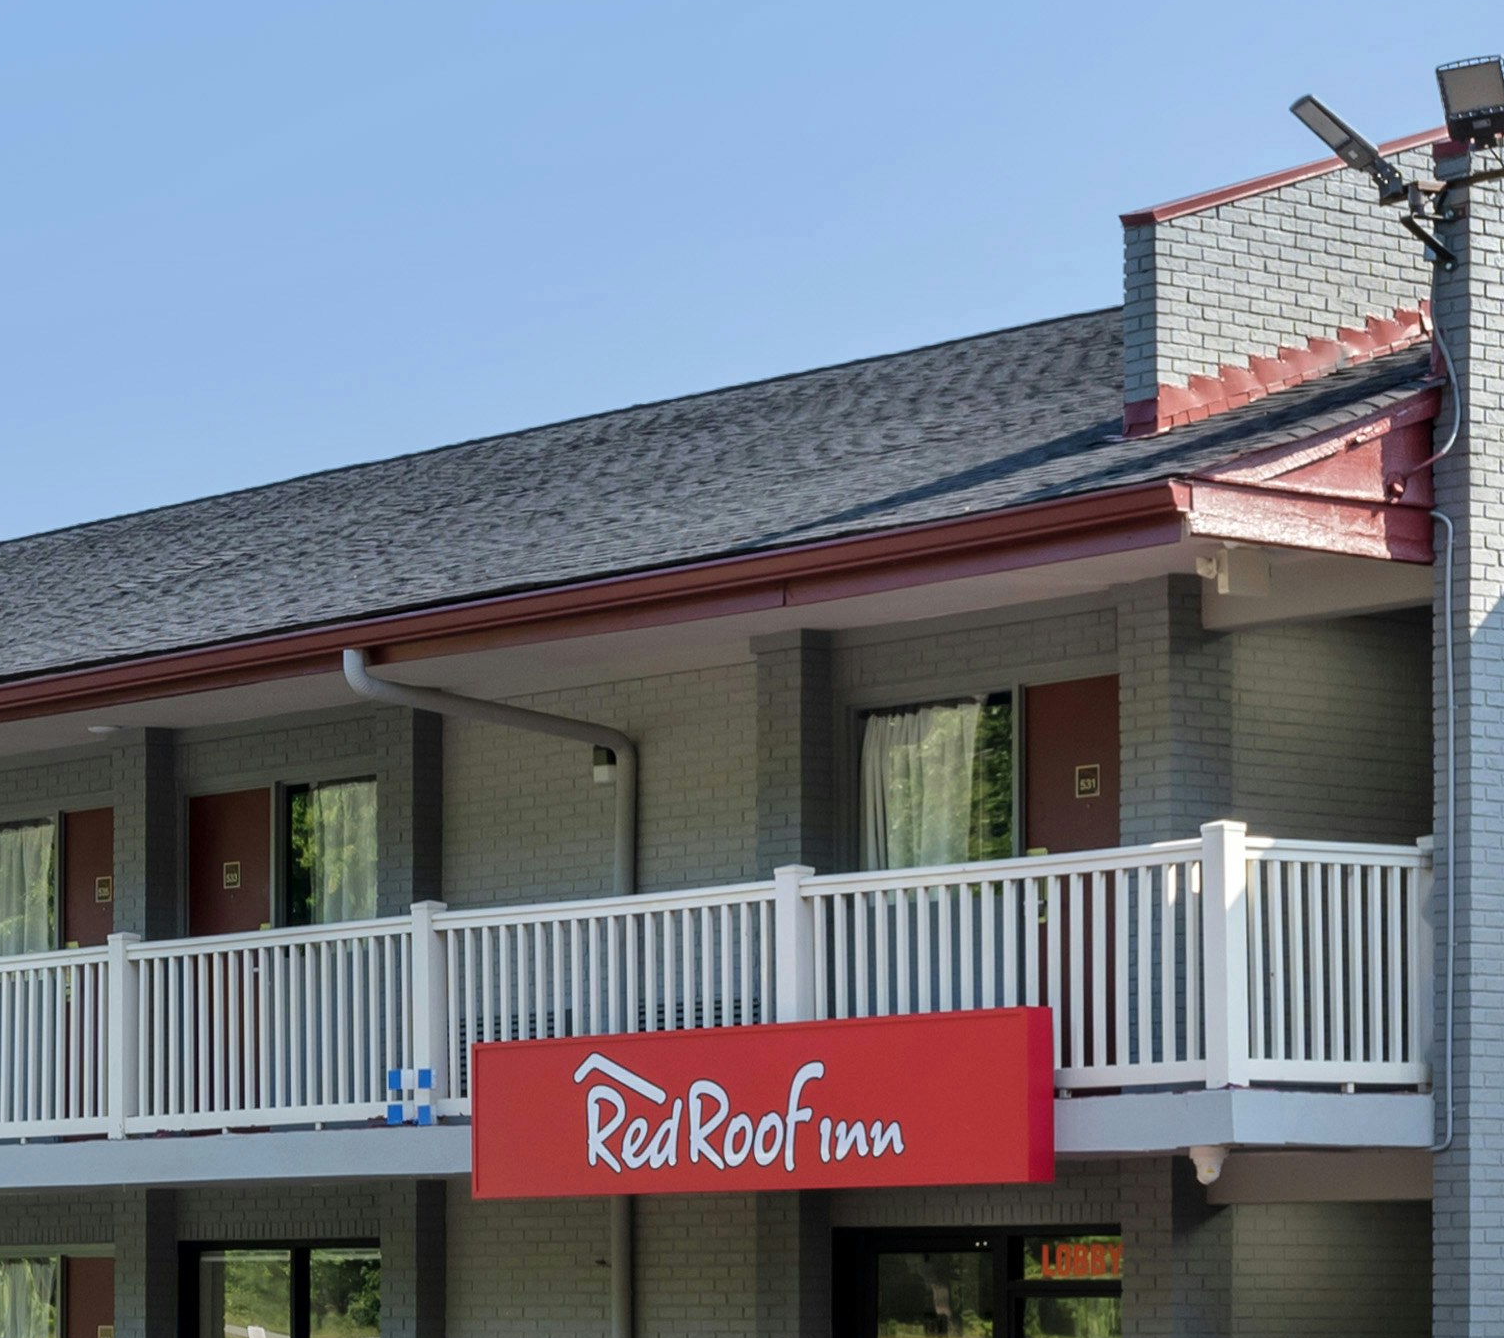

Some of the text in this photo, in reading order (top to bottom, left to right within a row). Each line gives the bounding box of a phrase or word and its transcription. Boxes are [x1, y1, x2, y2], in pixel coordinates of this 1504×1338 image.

[586, 1084, 683, 1173] Red
[688, 1060, 825, 1172] Roof
[1042, 1243, 1124, 1277] LOBBY
